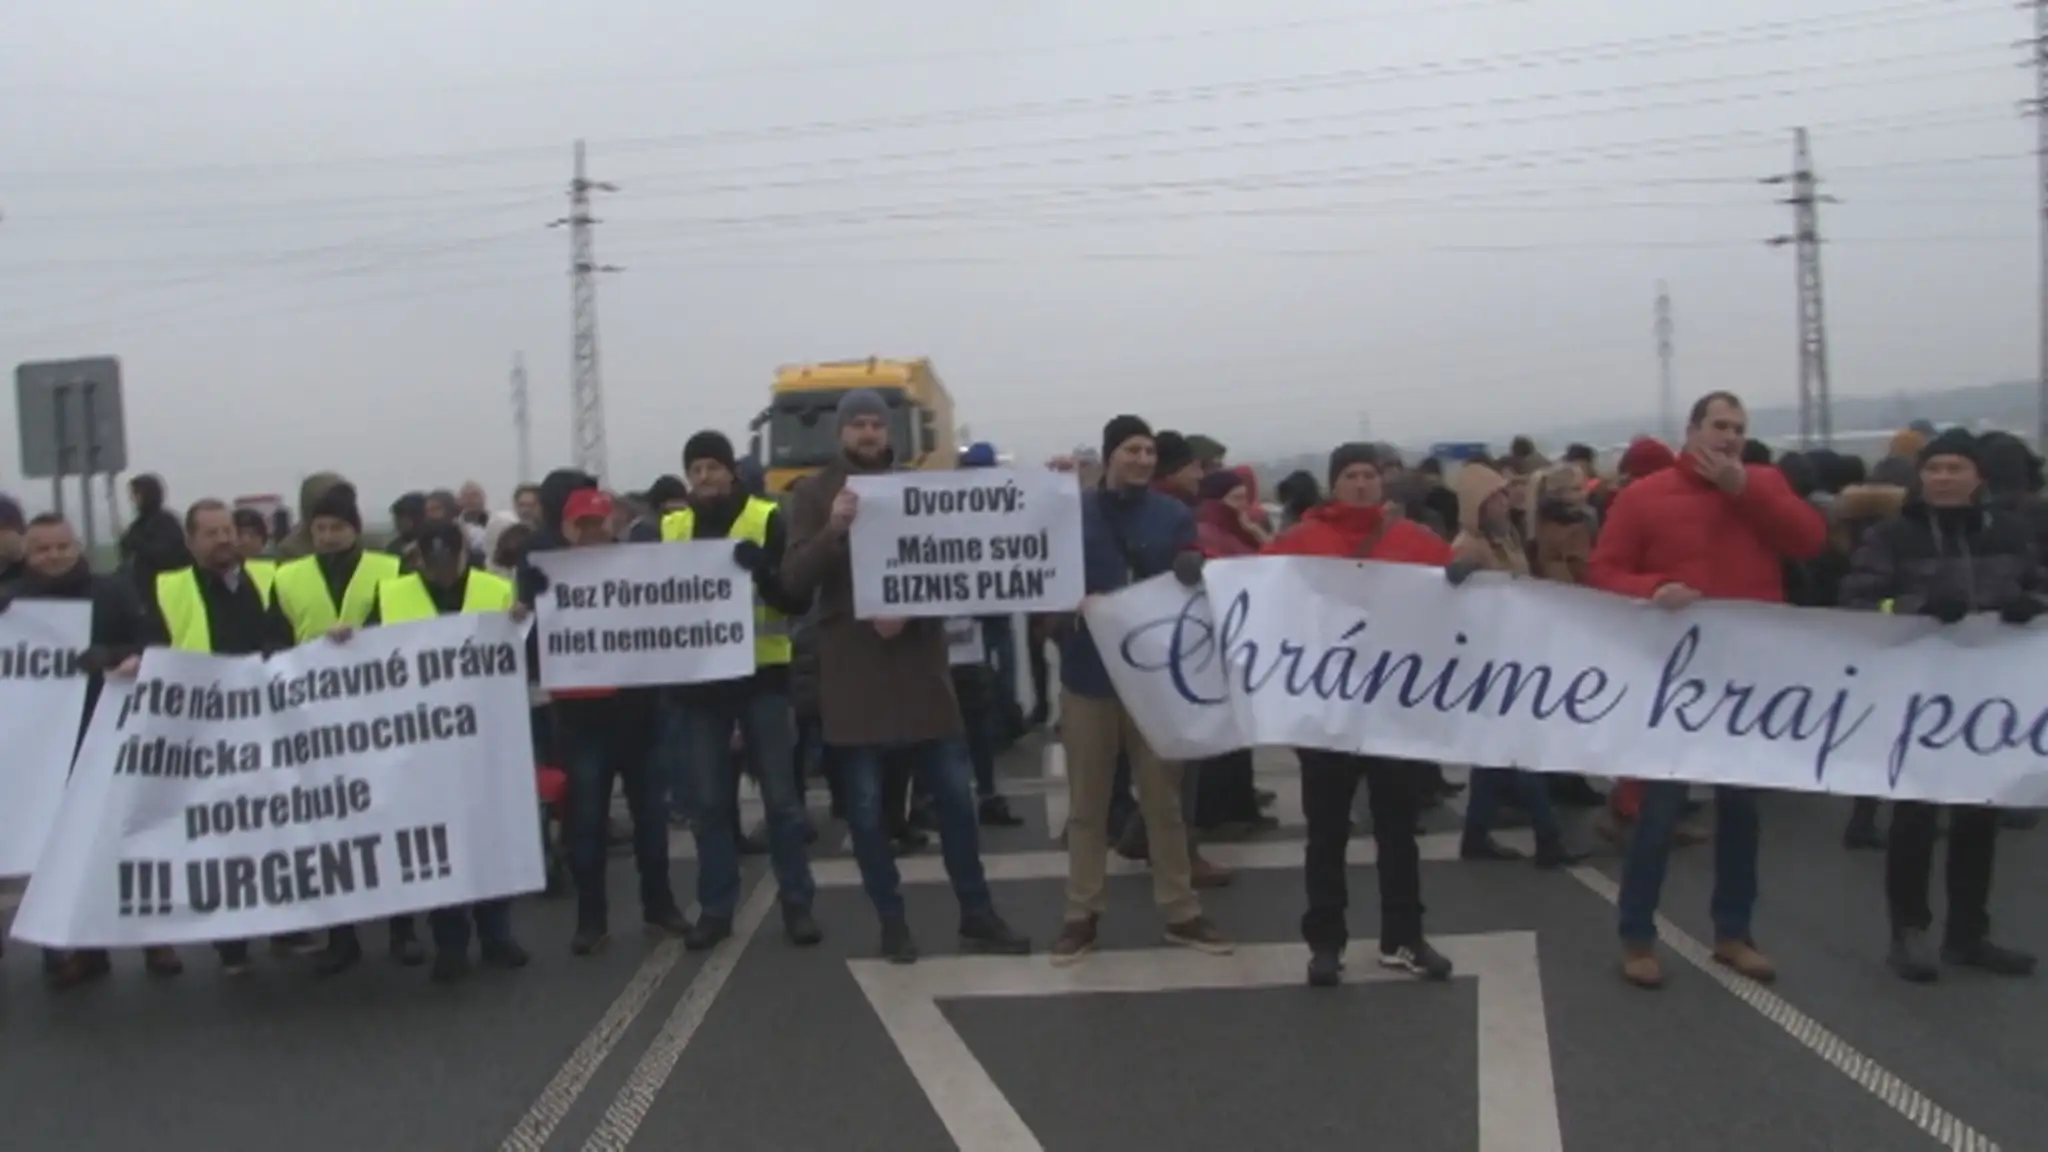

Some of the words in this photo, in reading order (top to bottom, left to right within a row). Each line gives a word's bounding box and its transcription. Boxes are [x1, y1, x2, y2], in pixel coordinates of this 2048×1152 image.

[904, 478, 1025, 517] Dvorový:
[990, 527, 1049, 562] svoj
[556, 583, 597, 609] Bez
[603, 575, 732, 608] Pôrodnice
[883, 571, 970, 604] BIZNIS
[548, 627, 597, 656] niet
[602, 620, 744, 653] nemocnice
[188, 680, 262, 720] nám
[267, 658, 408, 713] ústavné
[417, 636, 518, 687] práva
[1120, 588, 1628, 723] Chránime
[1647, 624, 1875, 782] kraj
[271, 700, 478, 770] nemocnica
[185, 777, 372, 839] potrebuje
[118, 861, 173, 916] !!!
[186, 834, 381, 914] URGENT
[395, 823, 452, 884] !!!
